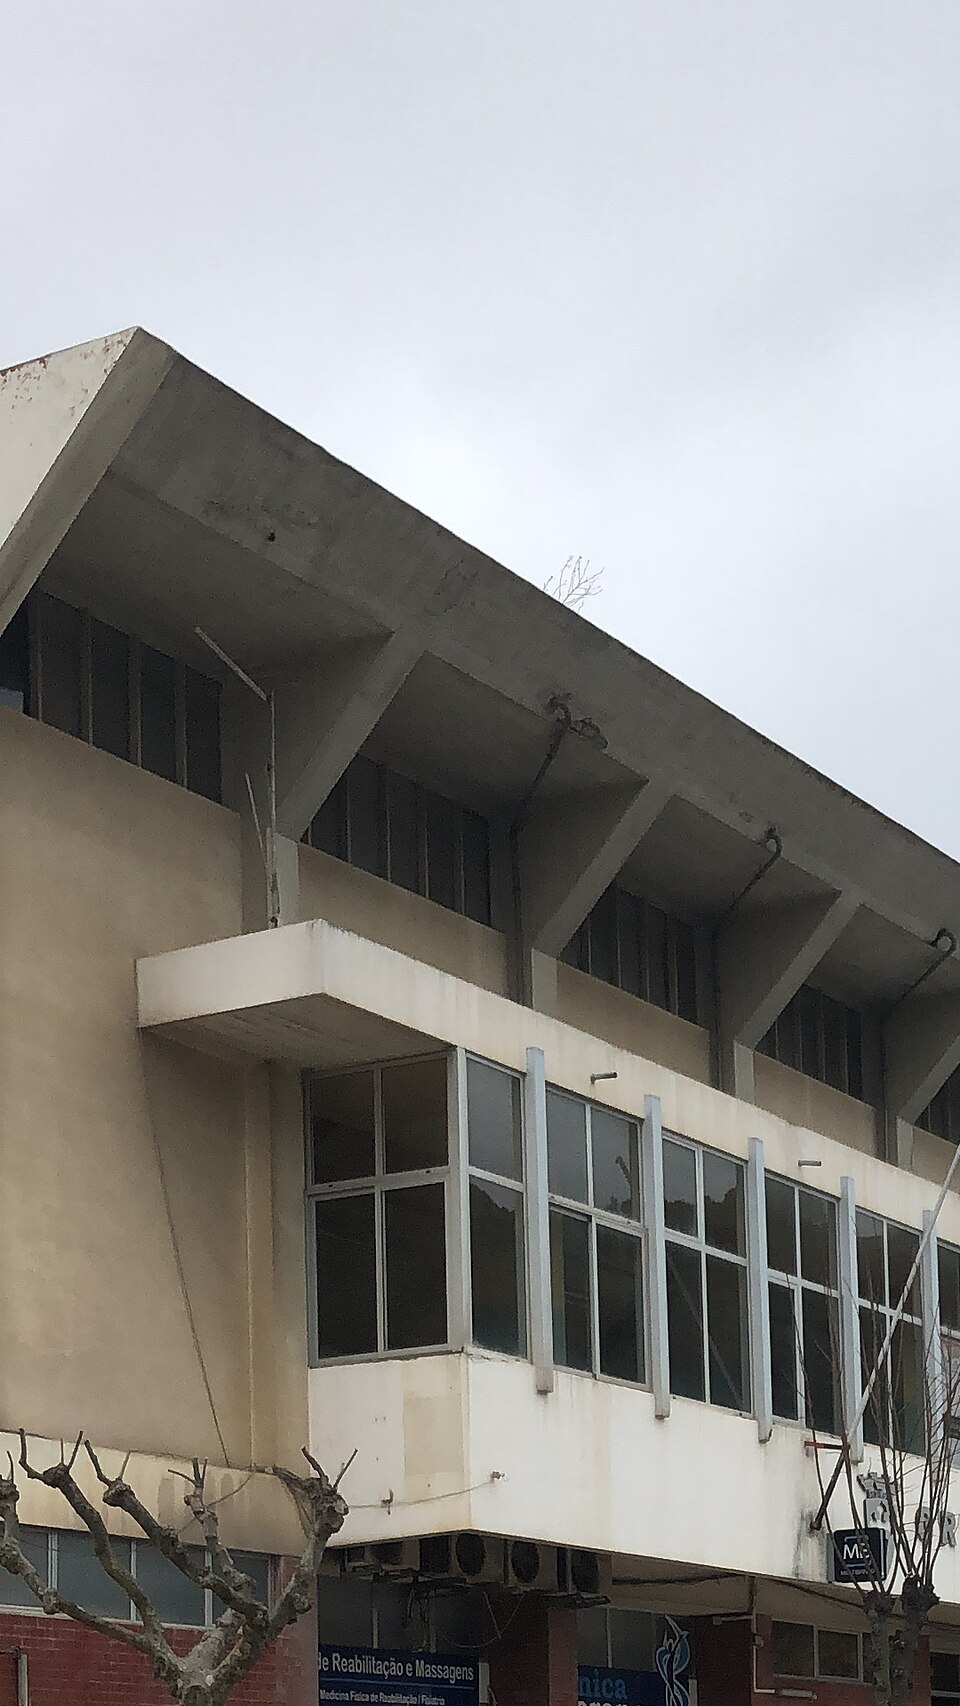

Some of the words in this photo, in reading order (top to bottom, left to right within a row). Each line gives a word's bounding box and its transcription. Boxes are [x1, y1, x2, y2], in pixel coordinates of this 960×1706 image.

[332, 1652, 403, 1679] Reabilitação
[406, 1662, 413, 1676] e
[415, 1659, 475, 1684] Massagens
